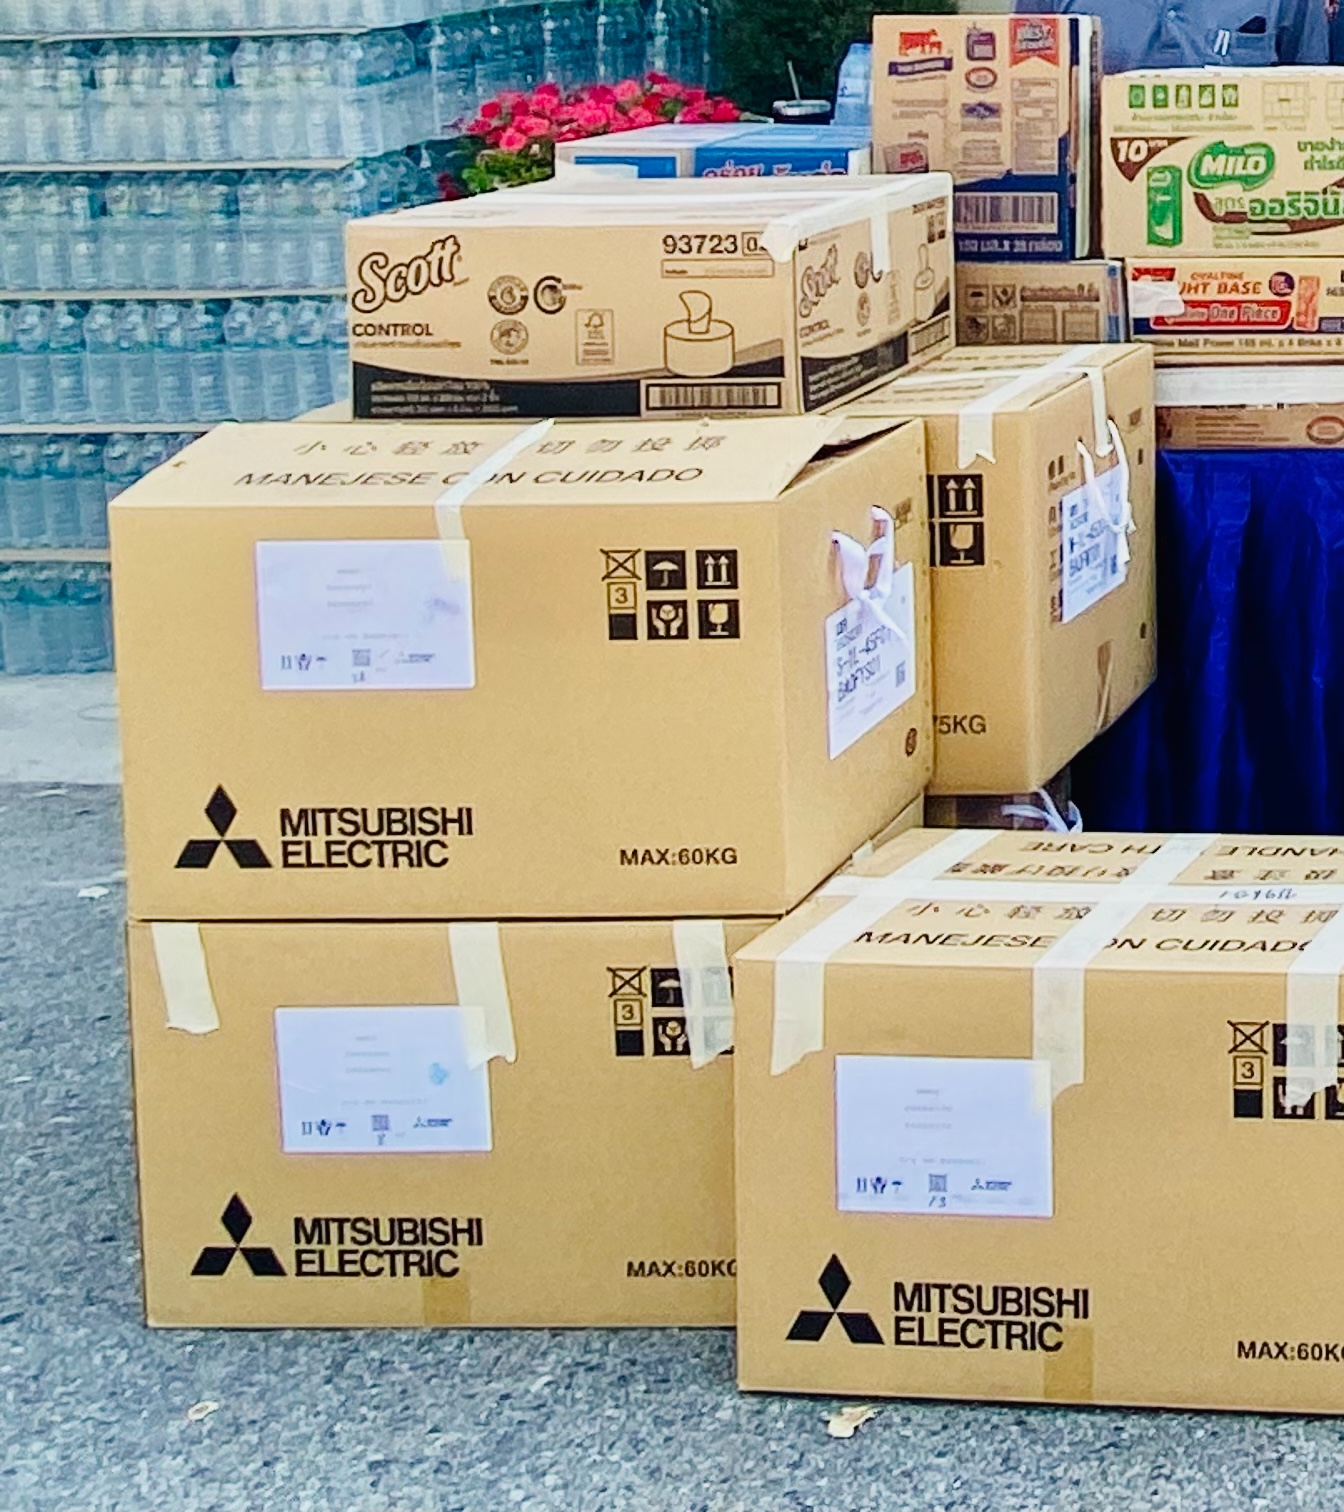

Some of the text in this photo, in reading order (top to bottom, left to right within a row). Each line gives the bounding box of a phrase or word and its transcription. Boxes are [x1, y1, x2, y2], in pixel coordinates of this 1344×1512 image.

[1115, 139, 1149, 163] 10
[1201, 154, 1269, 178] MILO
[662, 234, 738, 255] 93723
[352, 234, 461, 313] Scott
[1216, 280, 1262, 296] BASE
[352, 322, 434, 338] CONTROL
[234, 469, 438, 487] MANEJESE
[531, 466, 706, 485] CUIDADO
[614, 588, 628, 605] 3
[932, 714, 988, 736] 5KG
[280, 807, 474, 838] MITSUBISHI
[281, 840, 449, 869] ELECTRIC
[619, 846, 739, 867] MAX:60KG
[855, 929, 1050, 950] MANEJESE
[620, 1004, 634, 1022] 3
[1241, 1061, 1255, 1080] 3
[294, 1217, 483, 1246] MITSUBISHI
[295, 1249, 460, 1278] ELECTRIC
[893, 1281, 1090, 1321] MITSUBISHI
[893, 1315, 1065, 1352] ELECTRIC
